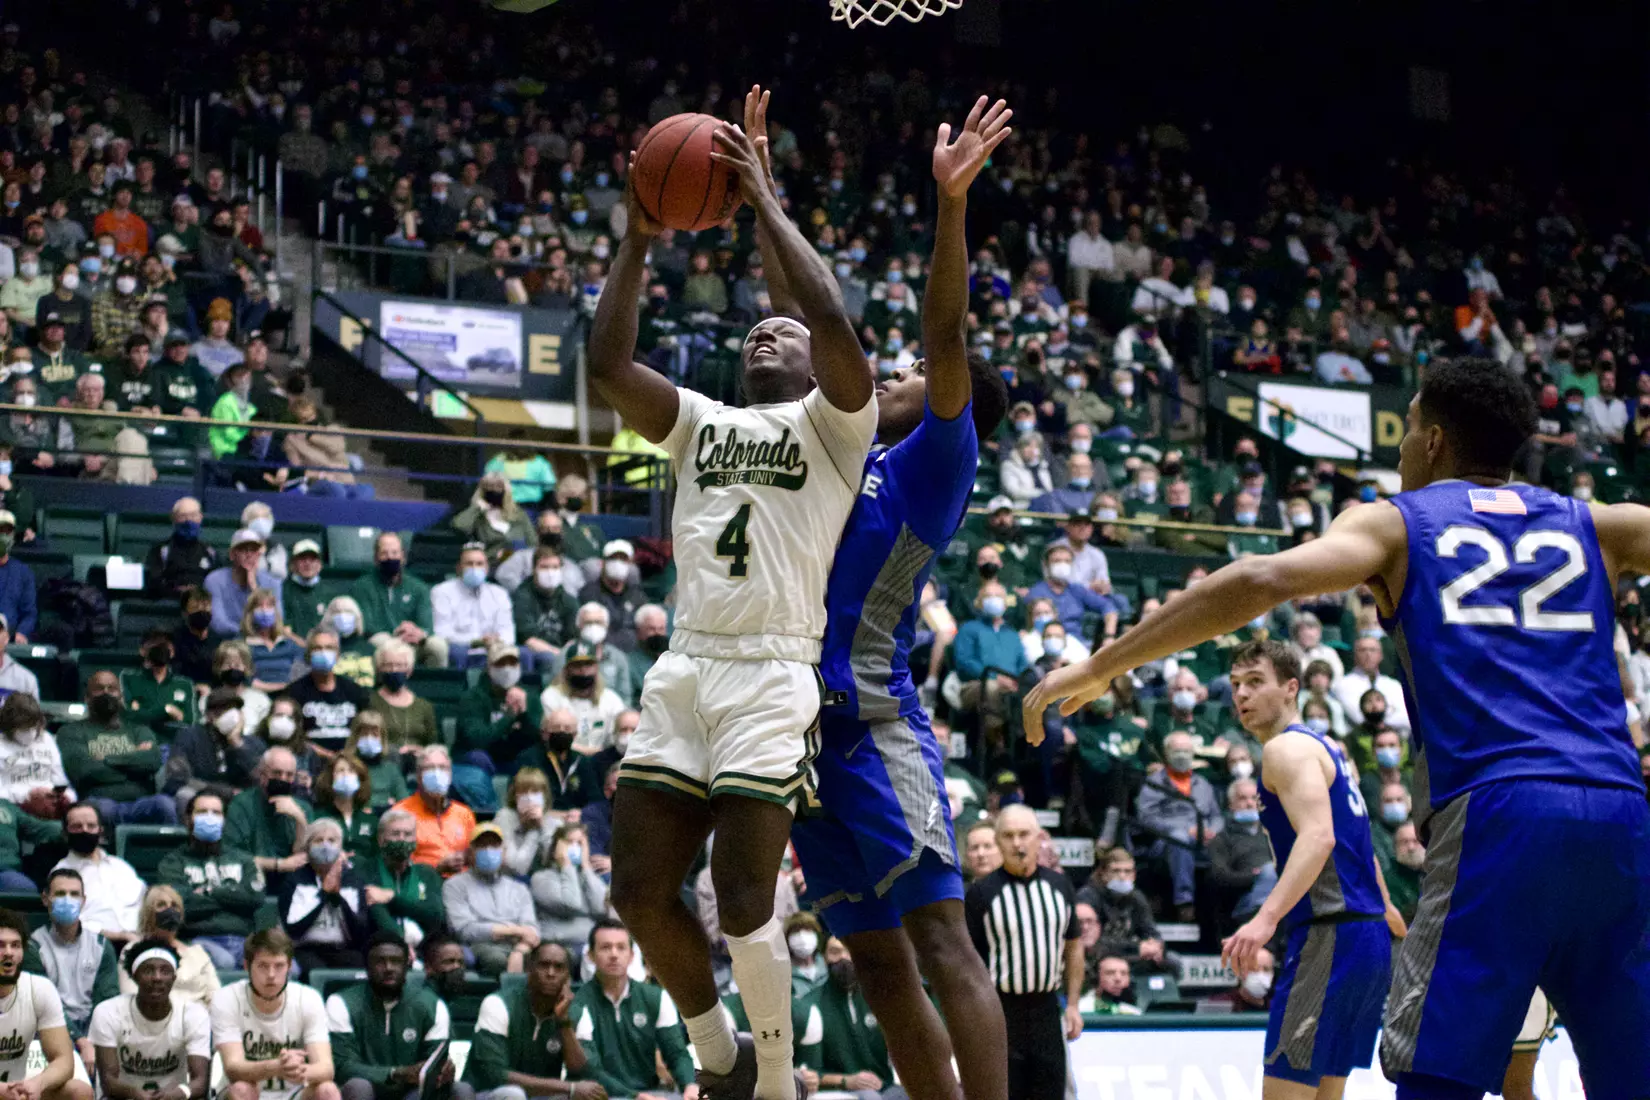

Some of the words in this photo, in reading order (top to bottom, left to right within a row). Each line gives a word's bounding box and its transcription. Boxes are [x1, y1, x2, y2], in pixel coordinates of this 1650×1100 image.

[529, 334, 561, 375] E
[695, 424, 805, 473] Colorado
[1376, 411, 1405, 447] D
[715, 472, 744, 486] STATE
[749, 471, 777, 486] UNIV
[715, 502, 752, 580] 4
[1436, 525, 1596, 633] 22
[120, 1045, 179, 1070] Colorado
